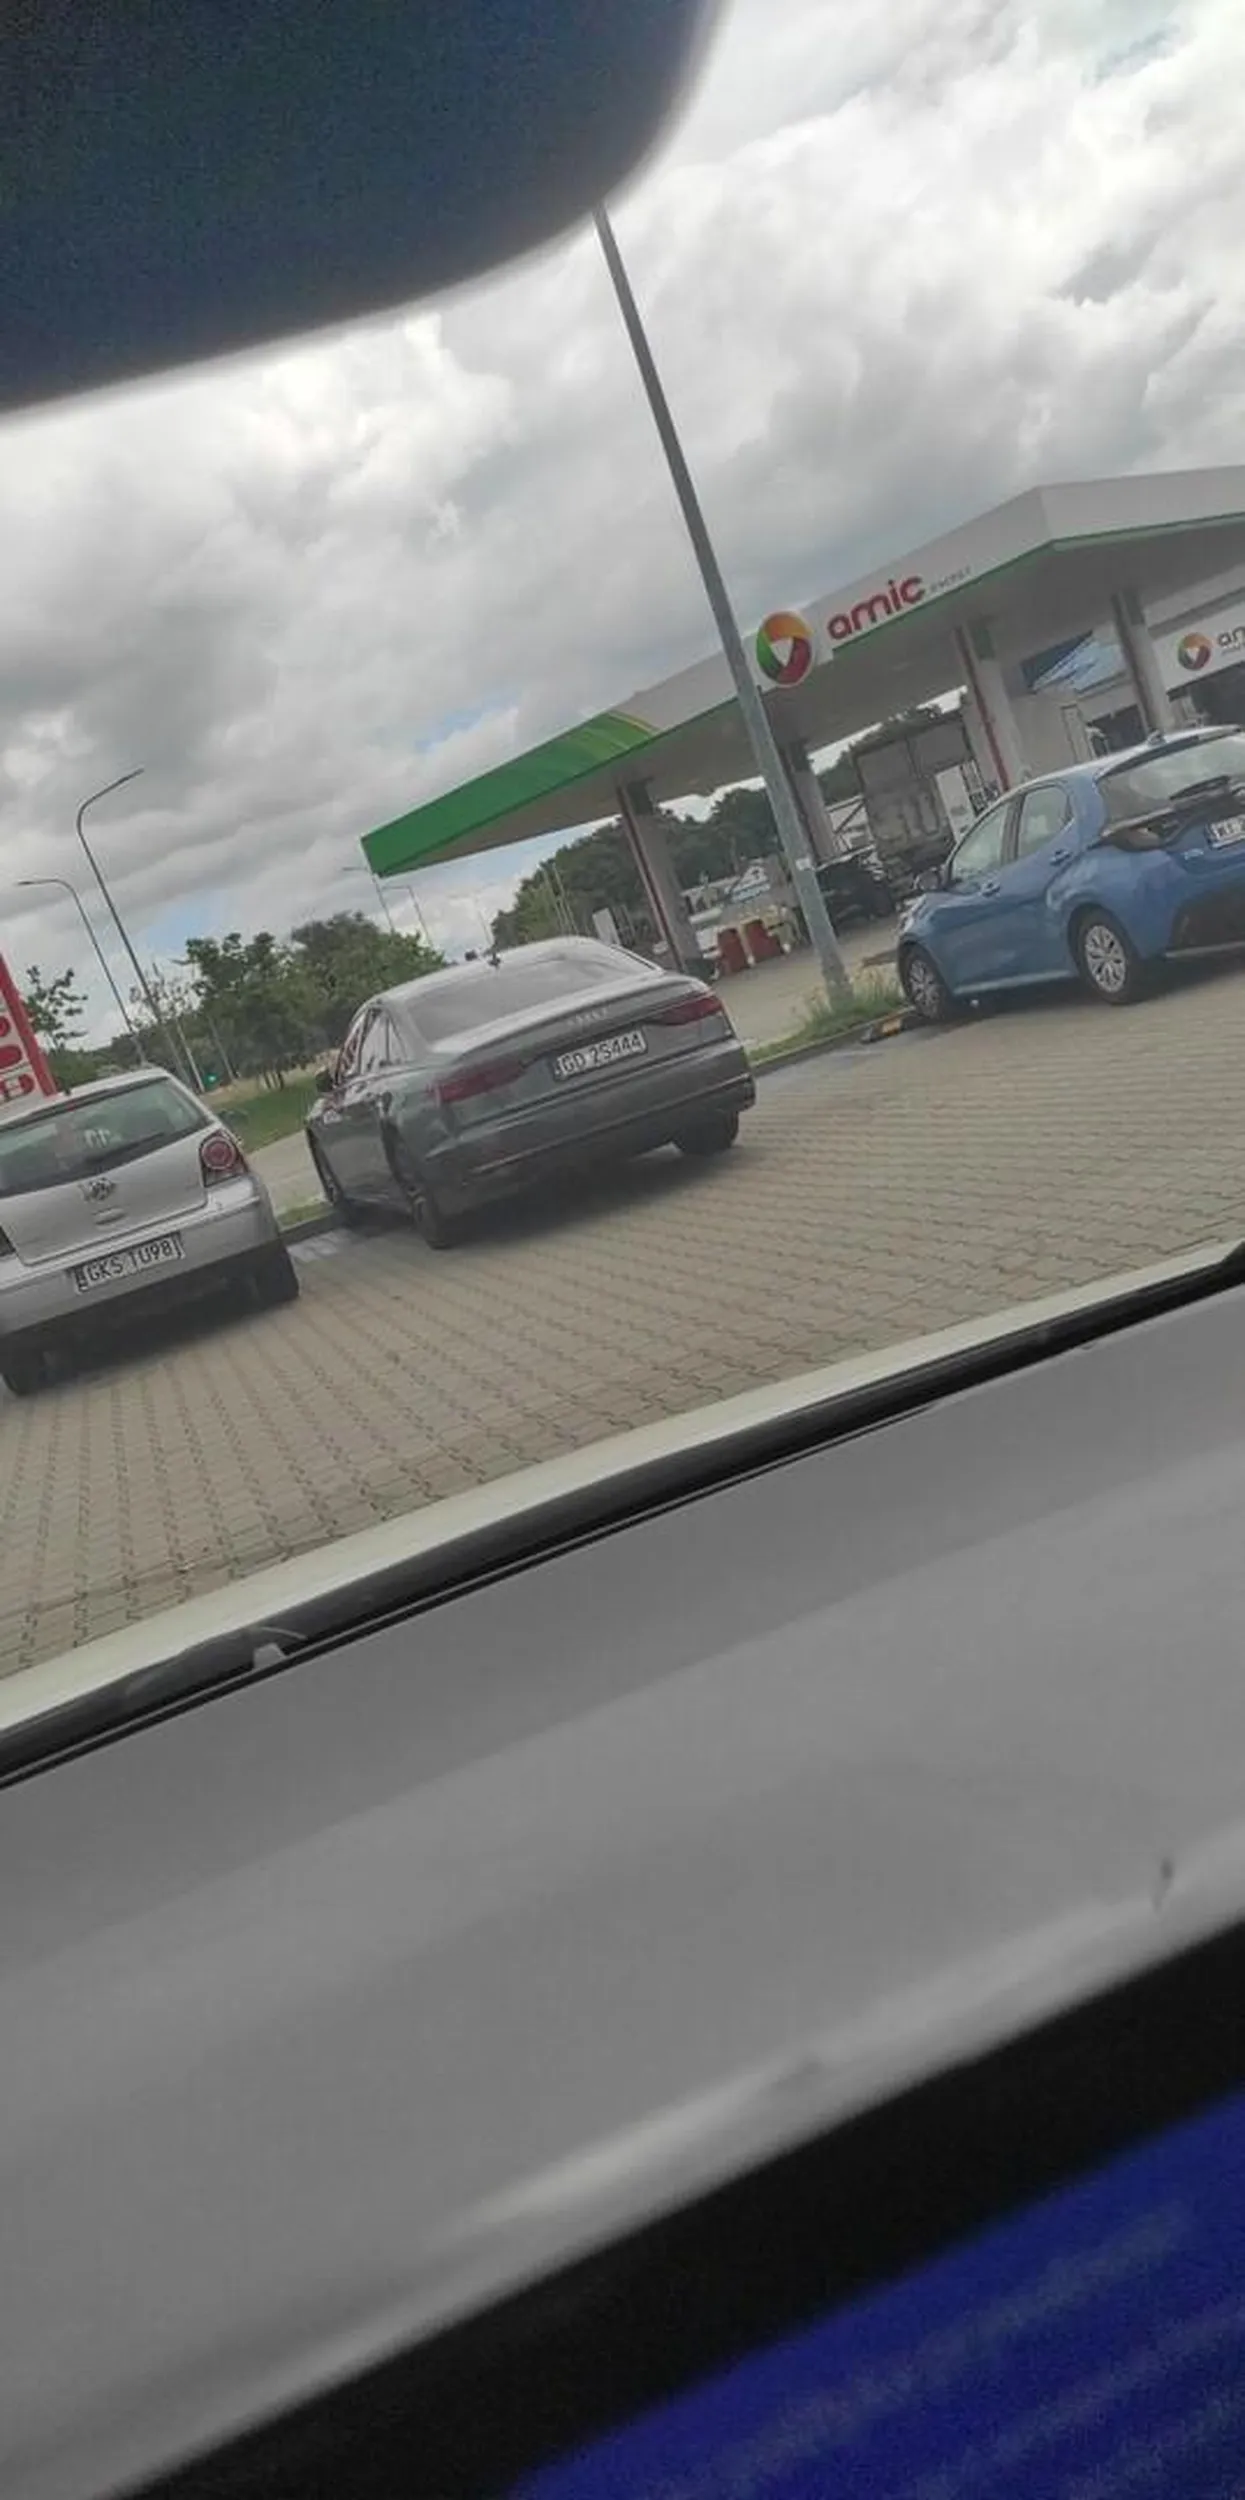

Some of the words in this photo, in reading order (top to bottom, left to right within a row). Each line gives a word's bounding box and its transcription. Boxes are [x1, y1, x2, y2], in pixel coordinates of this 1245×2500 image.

[827, 575, 926, 640] amic
[562, 1051, 586, 1073] GD
[87, 1255, 124, 1281] GKS
